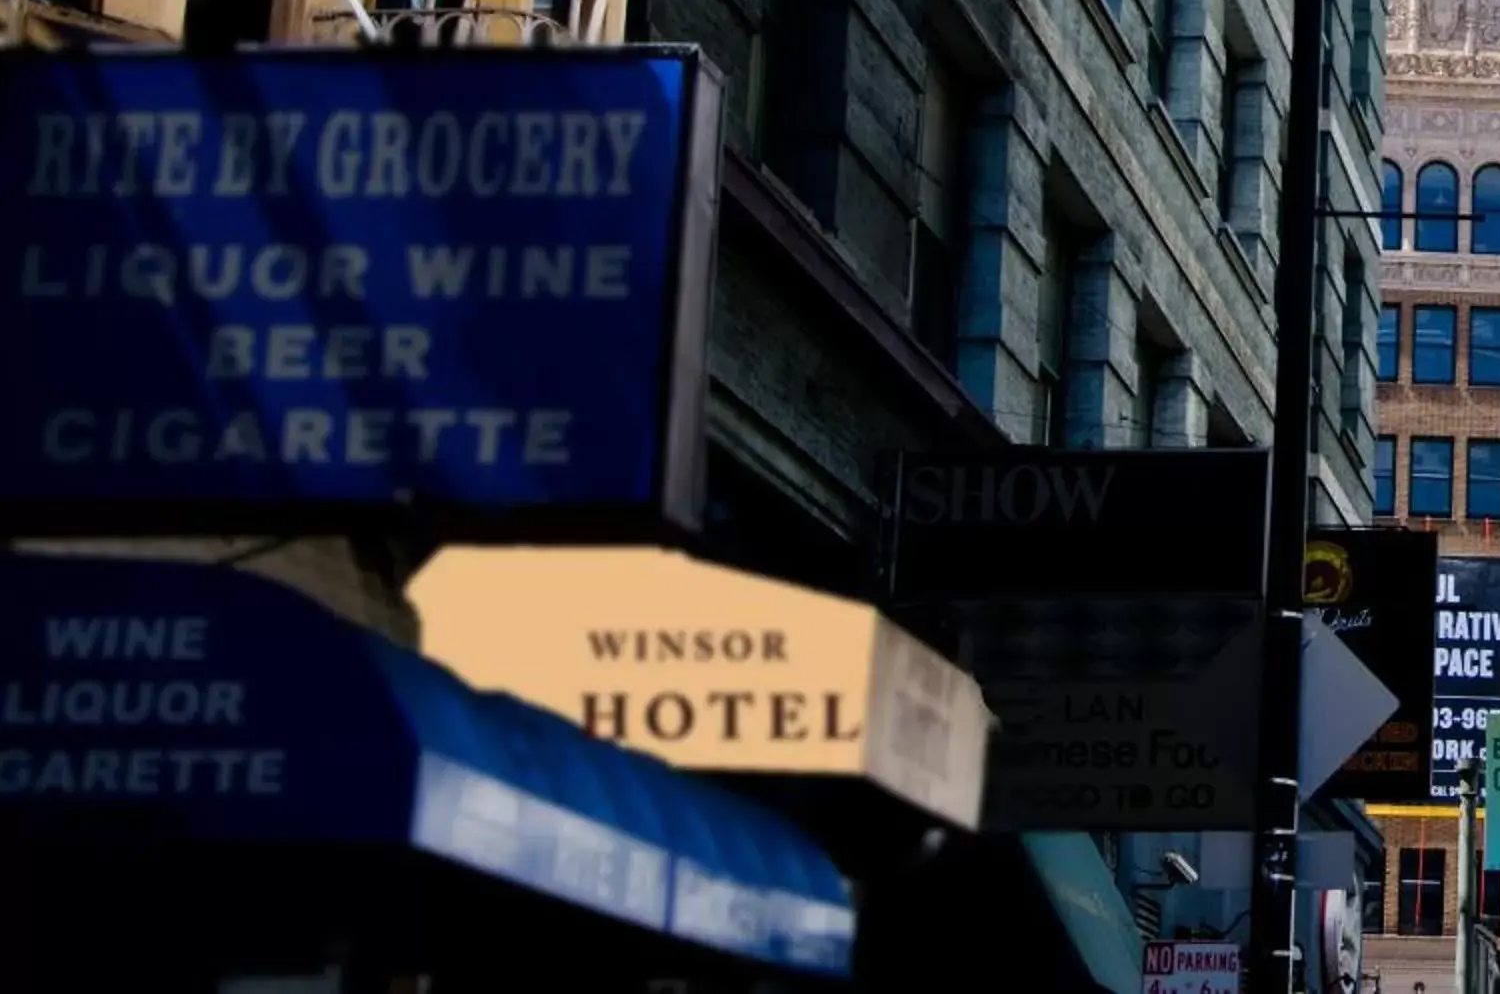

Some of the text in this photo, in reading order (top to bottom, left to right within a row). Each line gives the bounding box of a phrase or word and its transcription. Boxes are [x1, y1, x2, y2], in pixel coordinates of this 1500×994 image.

[25, 110, 648, 200] RITE BY GROCERY
[20, 243, 635, 309] LIQUOR WINE
[206, 324, 433, 382] BEER
[42, 407, 575, 466] CIGARETTE
[904, 463, 1119, 526] SHOW
[44, 614, 211, 662] WINE
[587, 629, 789, 662] WINSOR
[1434, 647, 1495, 678] PACE
[1, 679, 248, 726] LIQUOR
[581, 690, 862, 741] HOTEL
[0, 747, 288, 796] GARETTE
[1146, 946, 1238, 973] NO PARKING
